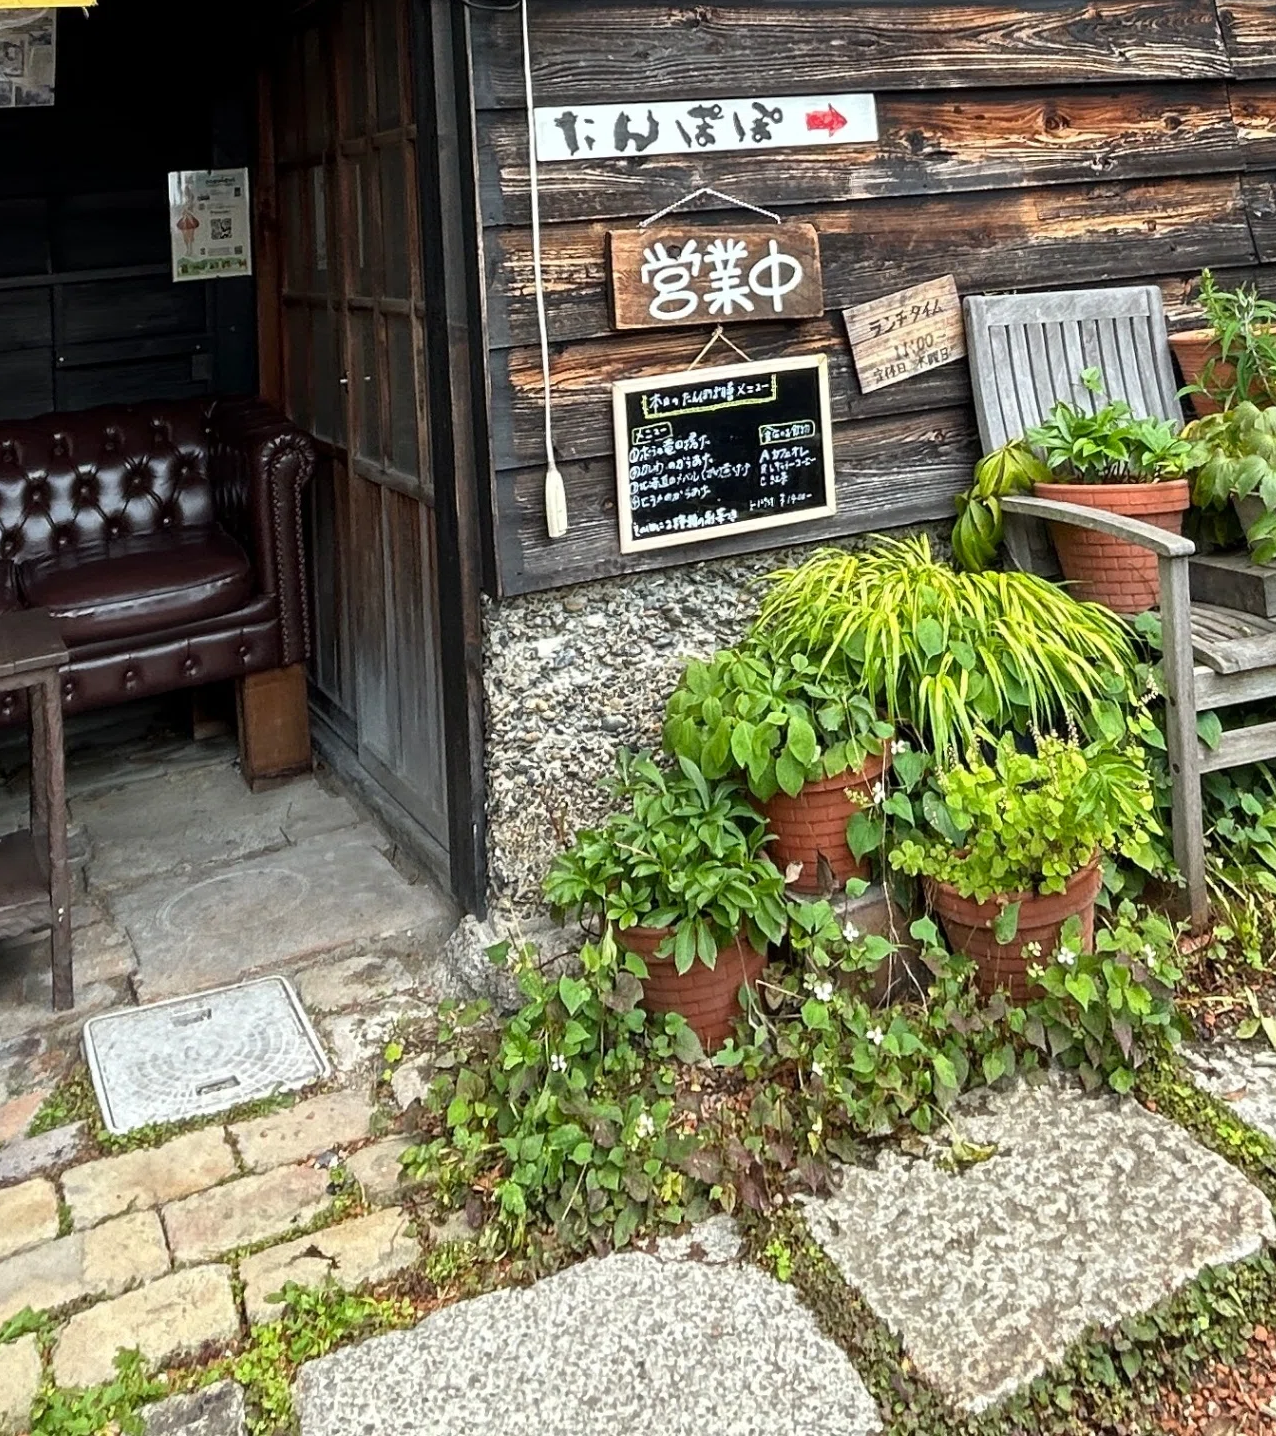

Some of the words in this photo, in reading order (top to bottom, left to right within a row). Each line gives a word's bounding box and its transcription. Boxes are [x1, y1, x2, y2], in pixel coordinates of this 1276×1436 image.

[555, 102, 783, 155] たんぽぽ
[640, 238, 803, 321] 営業中
[868, 298, 943, 338] ランチタイム
[872, 361, 907, 384] 定休日
[635, 427, 668, 443] メニュー
[759, 449, 770, 464] A
